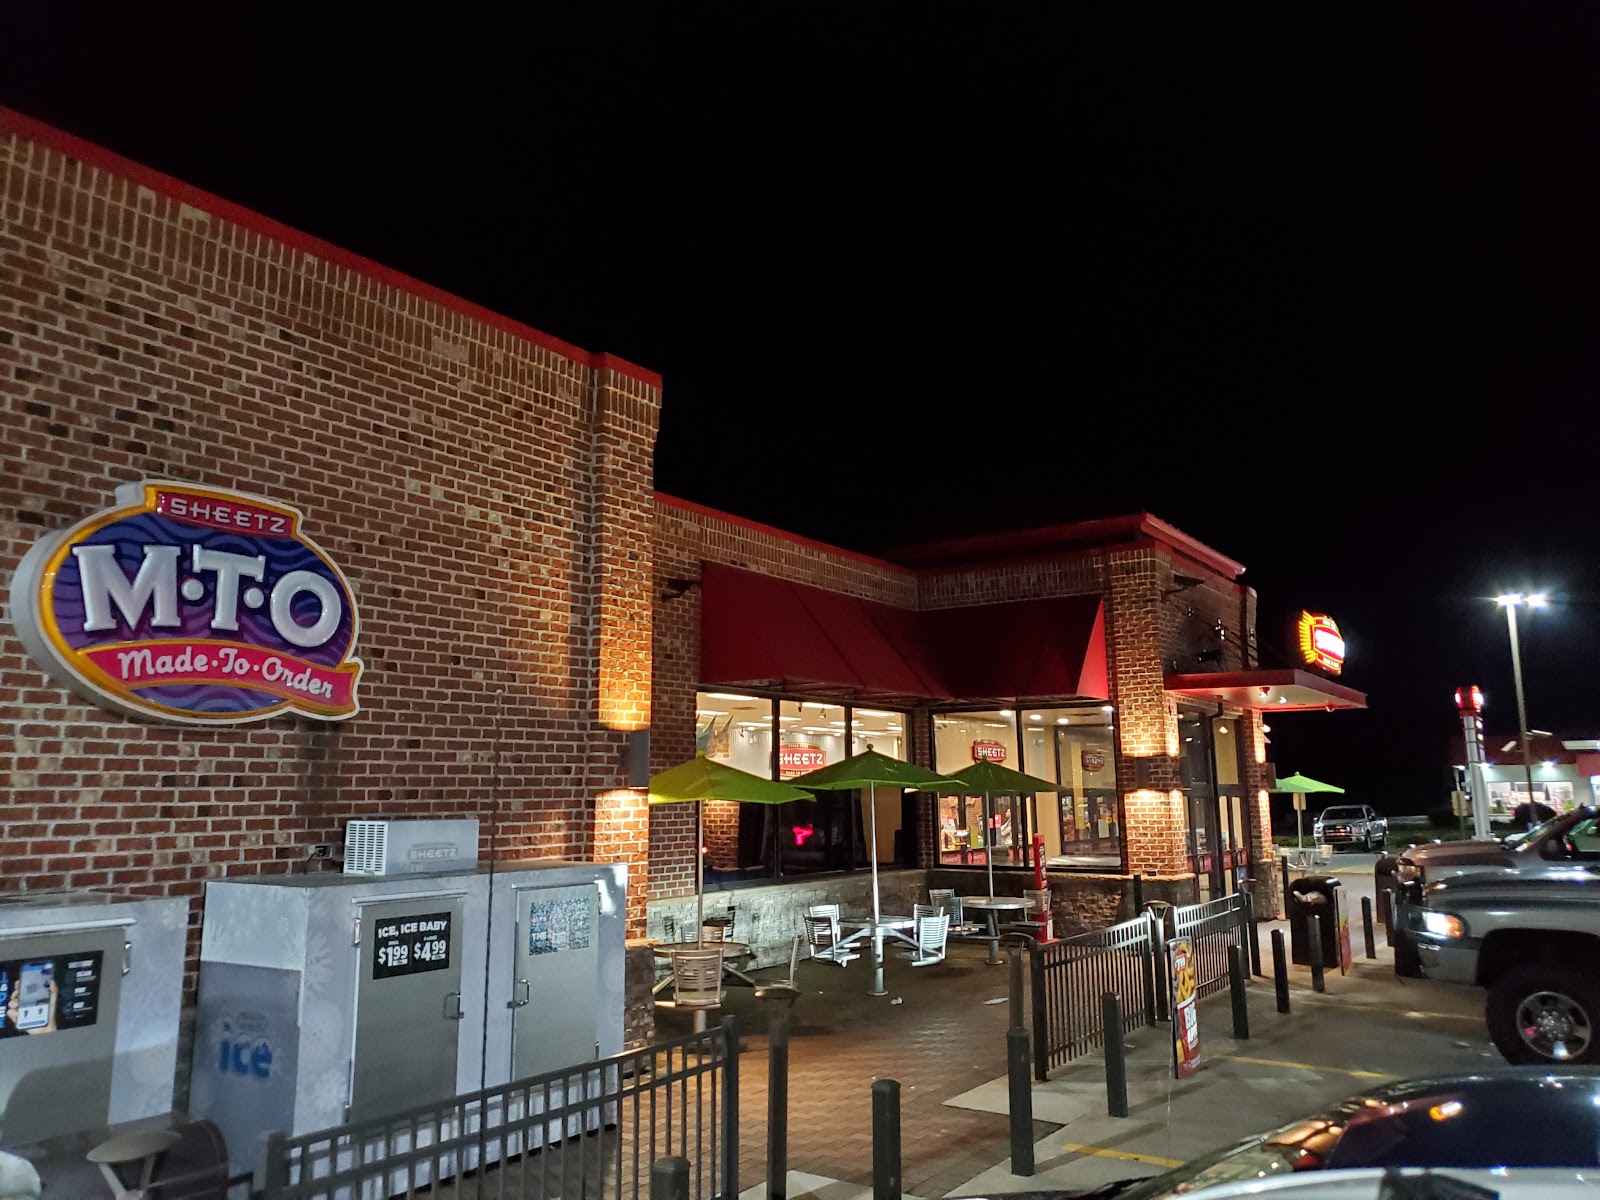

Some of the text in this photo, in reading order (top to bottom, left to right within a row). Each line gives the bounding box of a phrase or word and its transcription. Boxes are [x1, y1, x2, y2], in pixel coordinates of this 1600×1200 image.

[170, 497, 286, 534] SHEETZ
[977, 747, 1005, 757] SHEETZ
[409, 848, 457, 859] SHEETZ
[378, 920, 448, 938] ICE, ICE BABY
